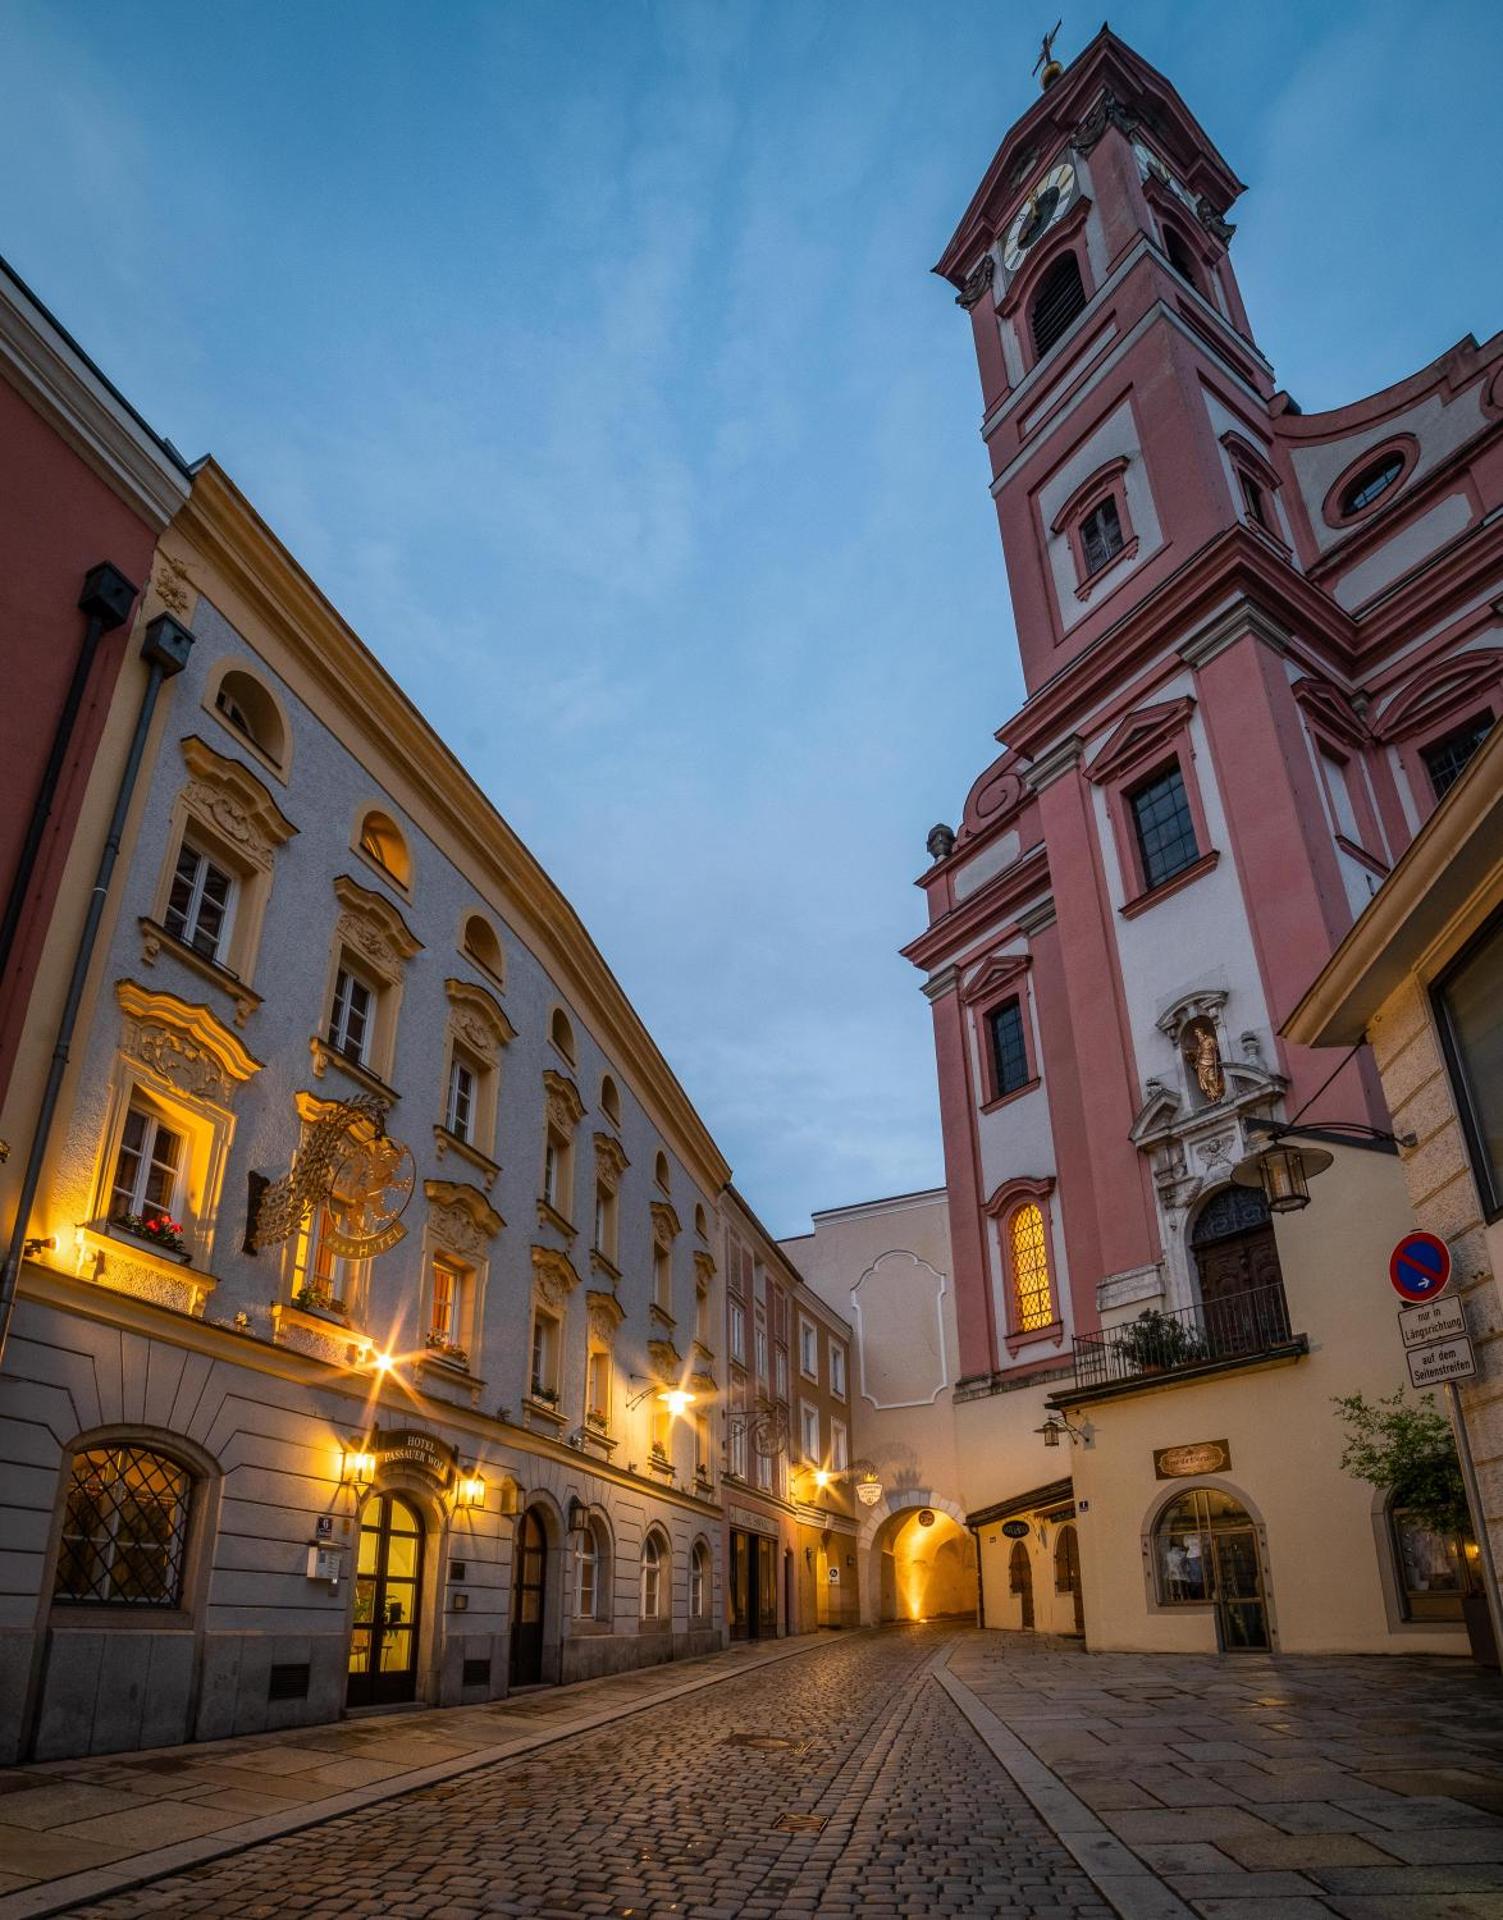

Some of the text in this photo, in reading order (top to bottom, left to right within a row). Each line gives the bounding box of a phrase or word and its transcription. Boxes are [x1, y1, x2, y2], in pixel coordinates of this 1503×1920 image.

[1418, 1308, 1441, 1321] nur in
[1405, 1318, 1462, 1340] Längsrichtung
[1422, 1349, 1457, 1365] auf dem
[1414, 1360, 1471, 1381] Seitenstreifen
[407, 1436, 436, 1454] HOTEL
[384, 1448, 427, 1463] PASSAUER
